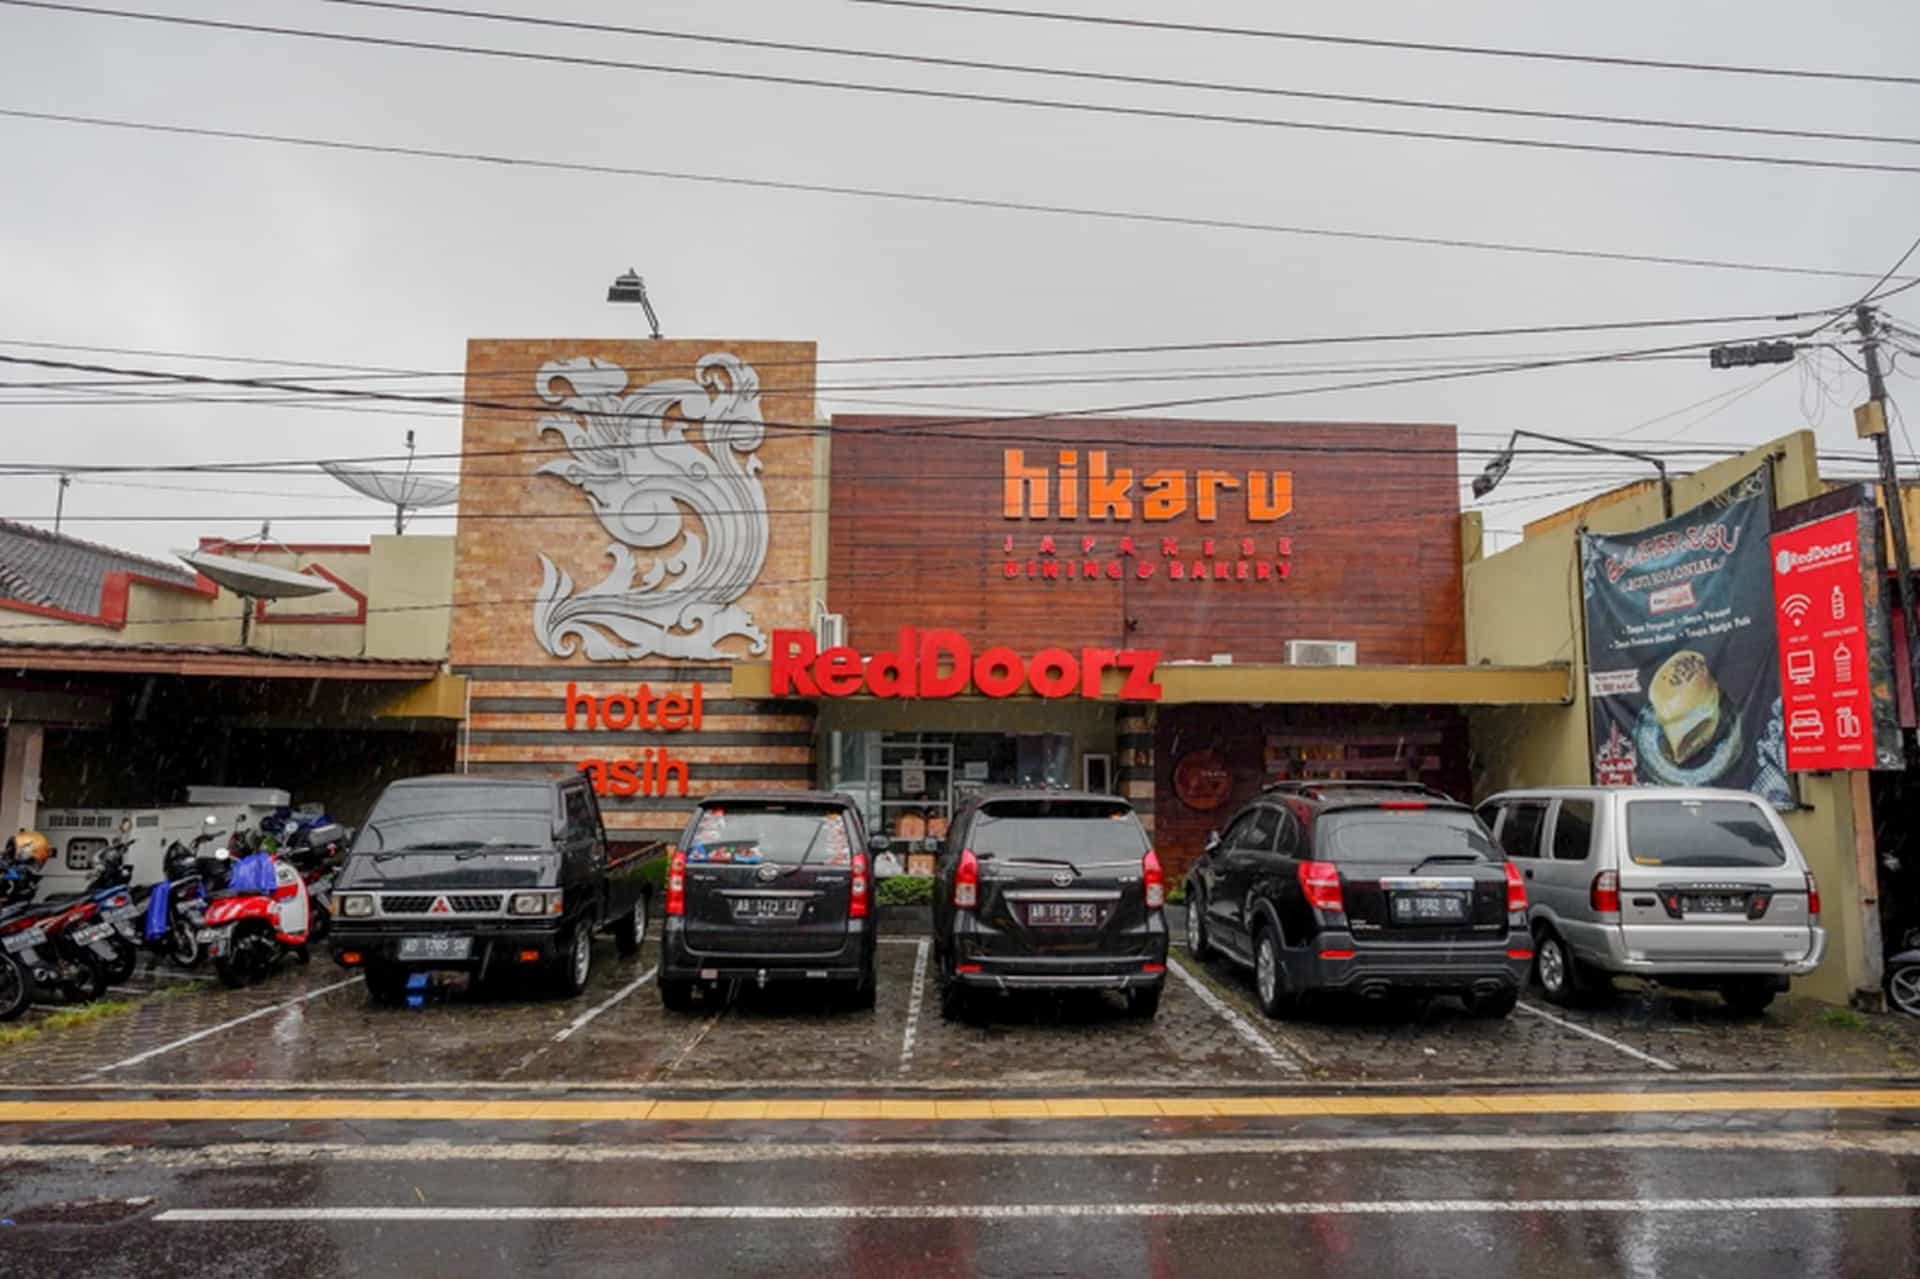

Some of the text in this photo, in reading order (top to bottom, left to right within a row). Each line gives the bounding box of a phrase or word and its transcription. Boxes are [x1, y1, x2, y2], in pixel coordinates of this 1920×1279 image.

[1003, 449, 1294, 522] hikaru
[1003, 534, 1292, 556] JAPANESE
[1169, 560, 1292, 581] BAKERY
[770, 627, 1162, 700] RedDoorz
[565, 680, 704, 731] hotel
[576, 745, 689, 797] asih
